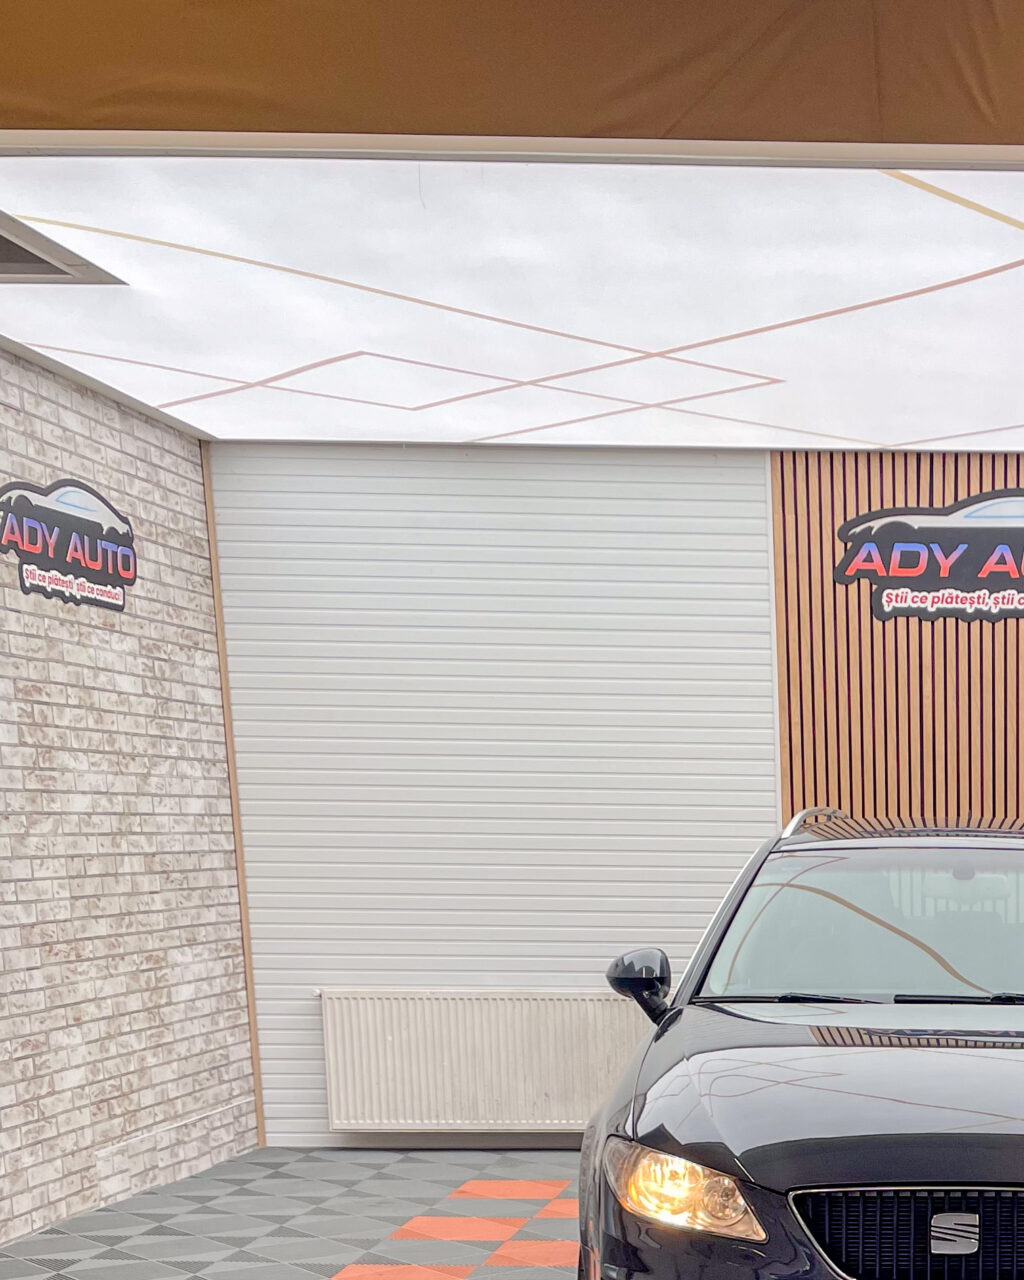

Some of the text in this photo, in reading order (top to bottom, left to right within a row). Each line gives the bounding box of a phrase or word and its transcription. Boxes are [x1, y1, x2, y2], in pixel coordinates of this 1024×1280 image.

[1, 512, 135, 579] ADY AUTO
[845, 542, 968, 577] ADY
[38, 573, 47, 582] ce
[87, 585, 95, 595] ce
[885, 591, 908, 607] Știi
[911, 595, 928, 604] ce
[930, 592, 989, 608] plătești,
[993, 593, 1015, 608] știi
